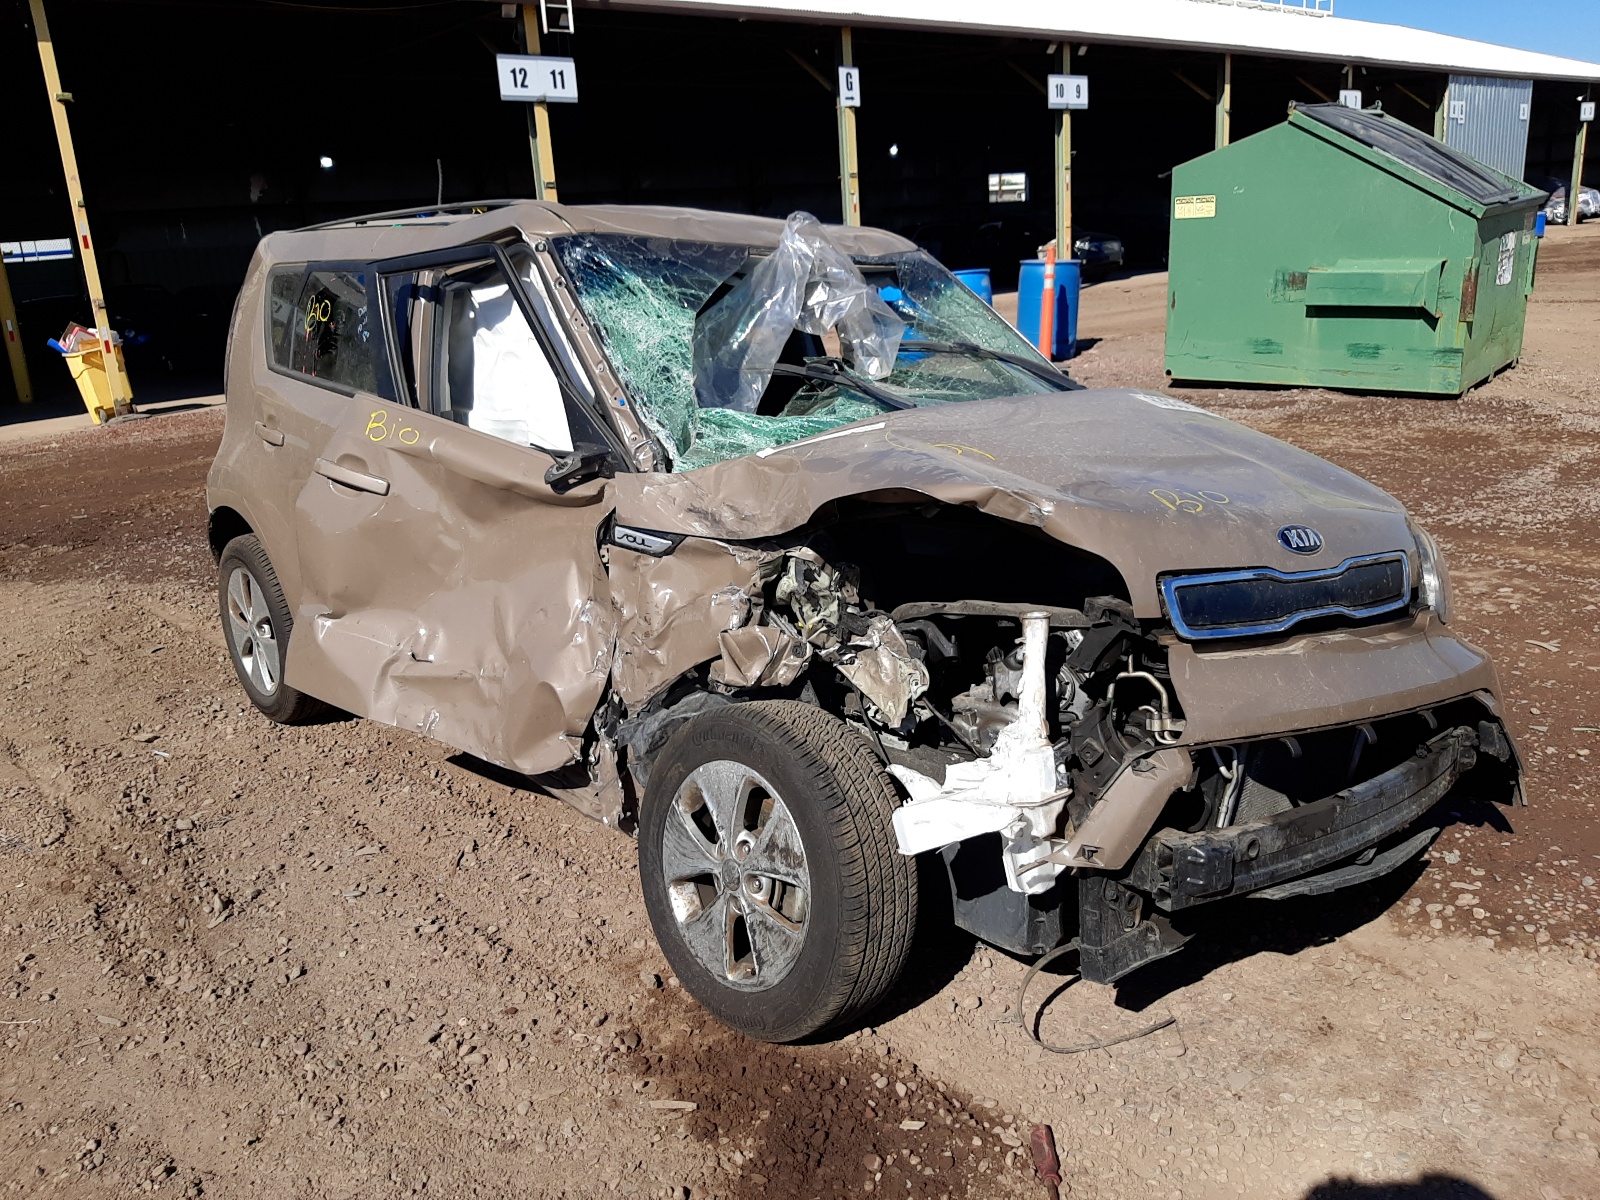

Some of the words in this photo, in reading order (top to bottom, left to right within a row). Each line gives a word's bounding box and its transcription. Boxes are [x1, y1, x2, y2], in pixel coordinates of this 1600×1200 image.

[509, 67, 529, 89] 12
[549, 69, 566, 90] 11
[845, 71, 854, 92] G
[1055, 83, 1065, 98] 10
[1075, 84, 1081, 99] 9
[1283, 528, 1321, 548] KIA
